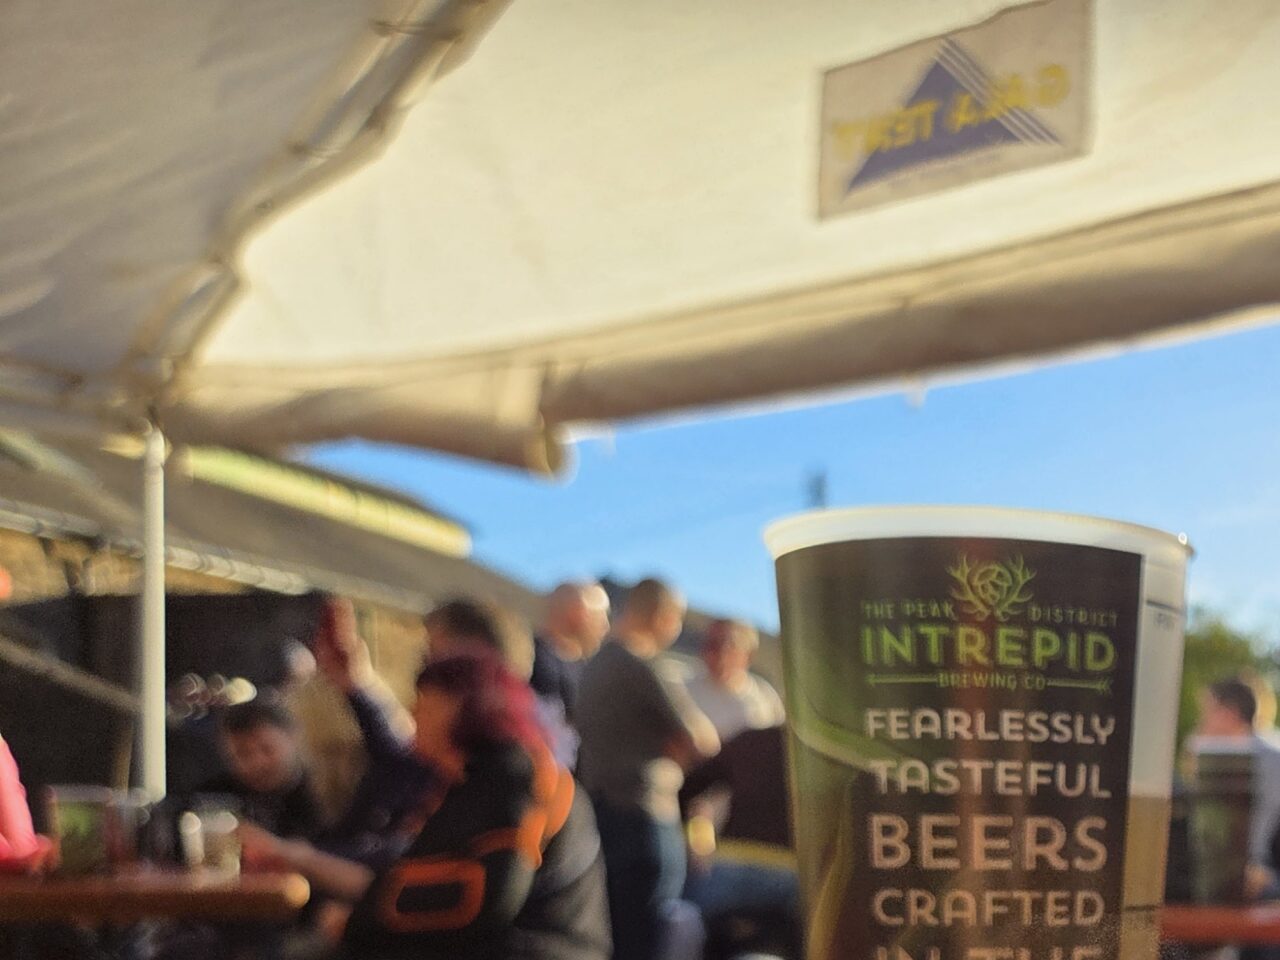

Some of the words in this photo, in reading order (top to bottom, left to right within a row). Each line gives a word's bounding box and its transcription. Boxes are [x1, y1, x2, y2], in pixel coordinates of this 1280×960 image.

[863, 602, 895, 620] THE
[904, 602, 957, 621] PEAK
[1028, 604, 1119, 628] DISTRICT
[863, 623, 1116, 671] INTREPID
[938, 671, 1017, 691] BREWING
[864, 707, 1116, 745] FEARLESSLY
[868, 758, 1111, 799] TASTEFUL
[870, 815, 1107, 870] BEERS
[873, 889, 1105, 928] CRAFTED
